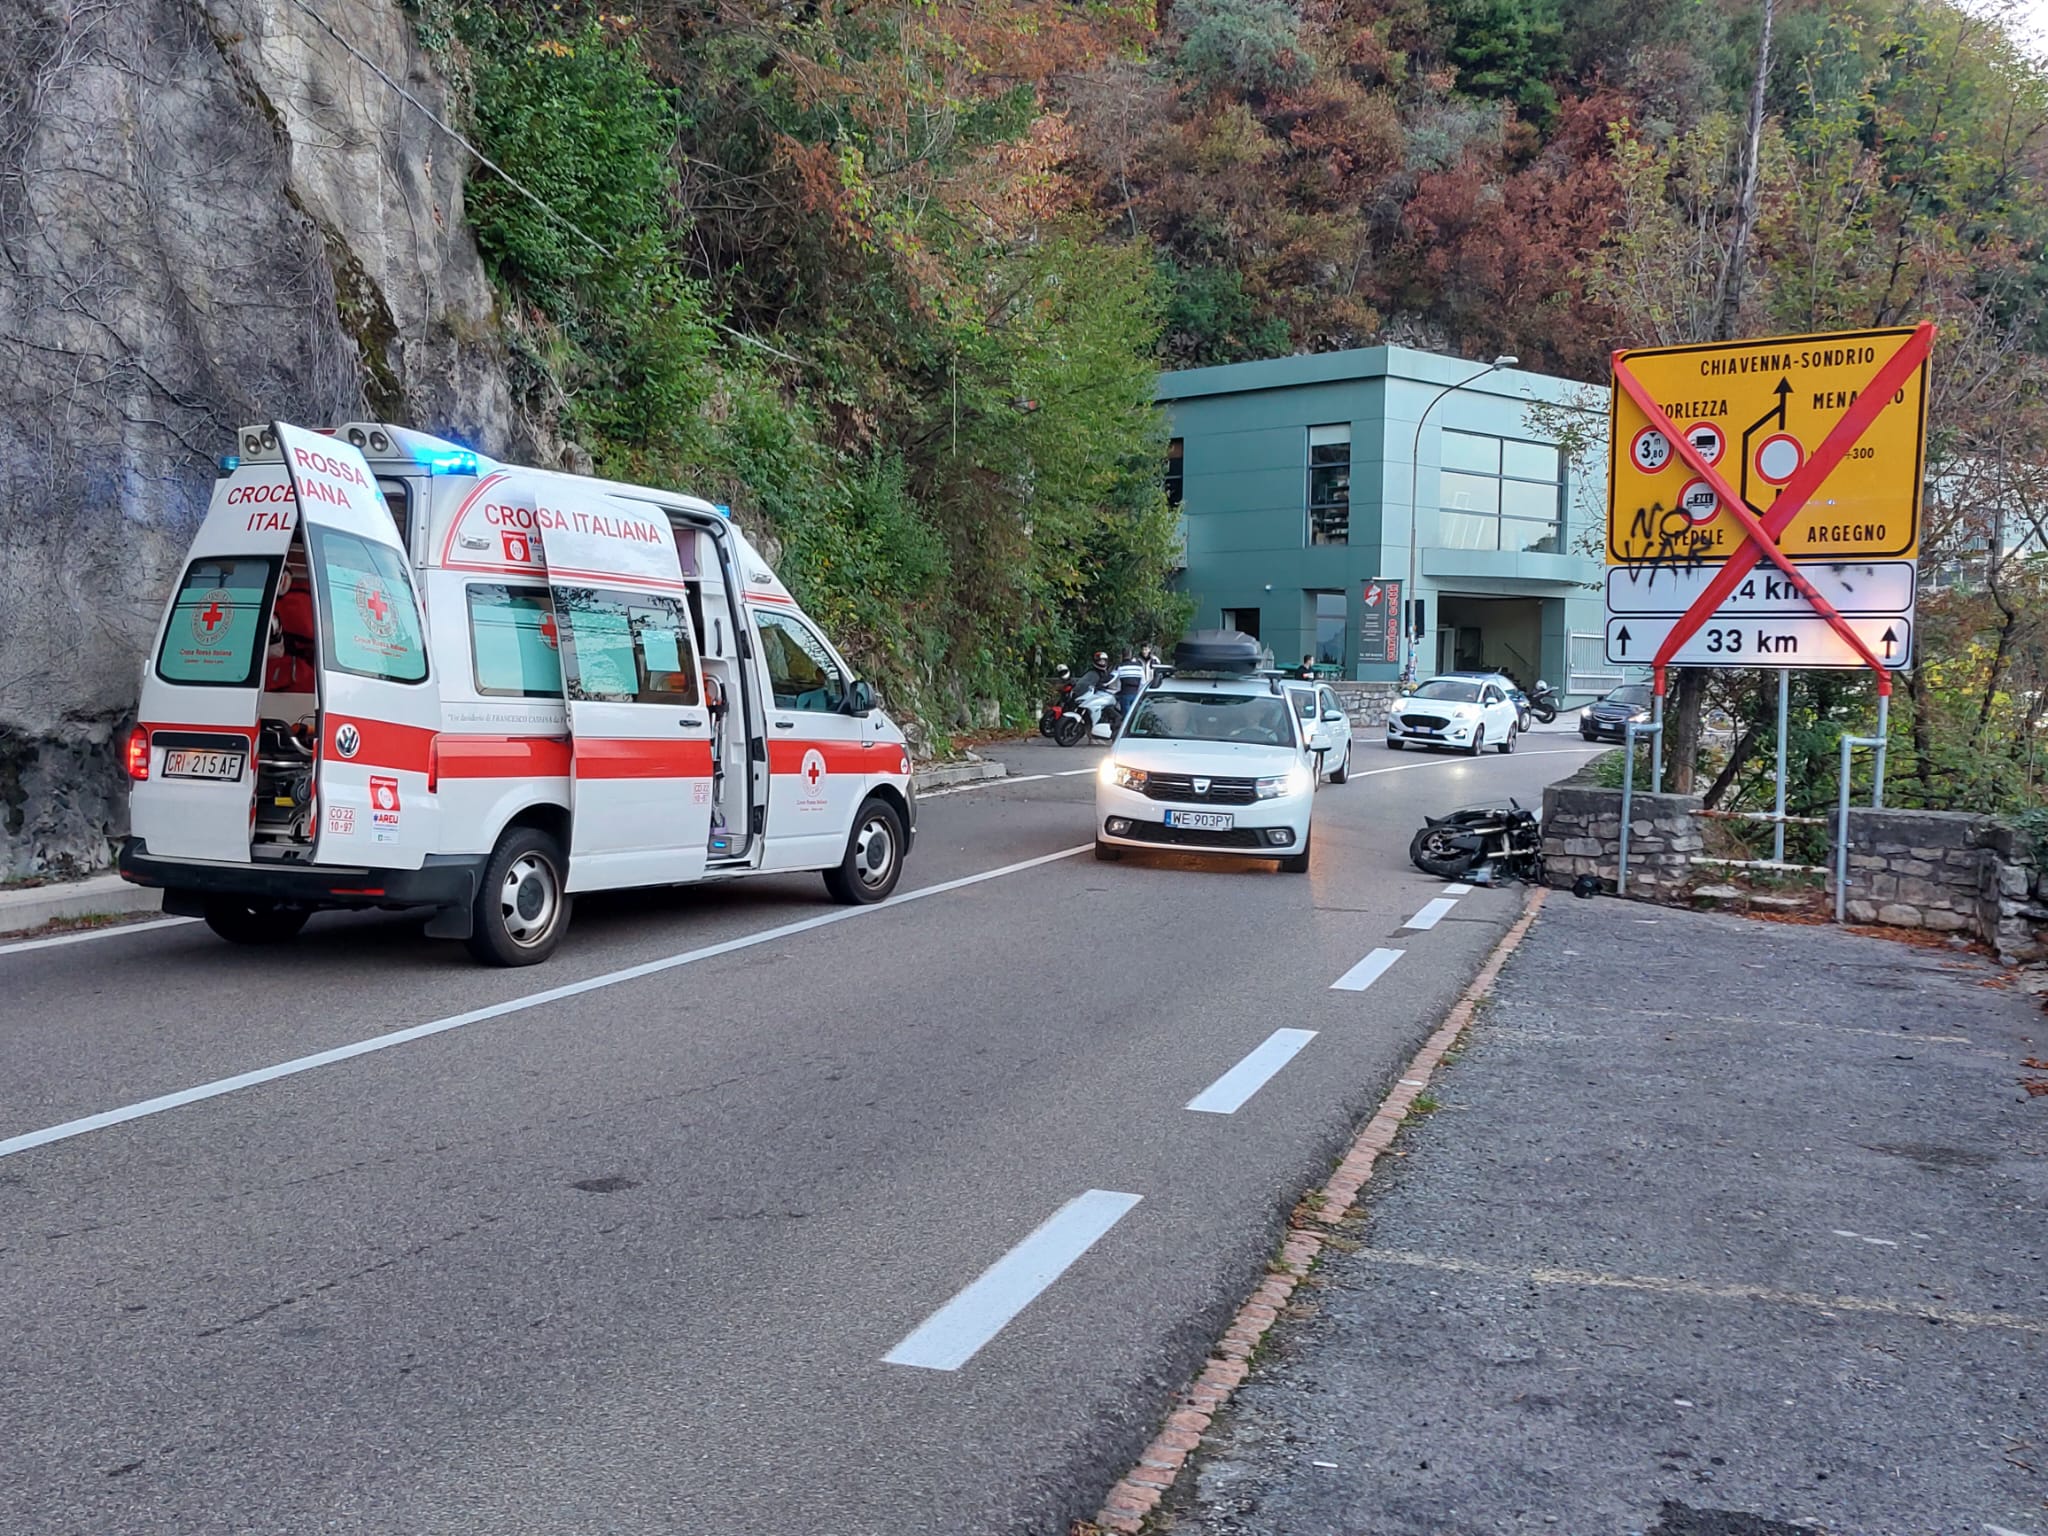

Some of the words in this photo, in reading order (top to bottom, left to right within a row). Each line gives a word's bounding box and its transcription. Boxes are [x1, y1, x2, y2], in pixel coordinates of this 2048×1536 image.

[1700, 346, 1876, 377] CHIAVENNA-SONDRIO
[1812, 388, 1905, 410] MENAO
[295, 447, 370, 488] ROSSA
[247, 512, 292, 532] ITAL
[572, 511, 662, 544] ITALIANA
[1630, 501, 1694, 540] NO
[1807, 523, 1887, 544] ARGEGNO
[1707, 629, 1743, 653] 33
[1757, 630, 1798, 653] km
[167, 752, 186, 773] CRI
[343, 809, 354, 820] 22
[1173, 812, 1192, 825] WE
[1194, 814, 1232, 828] 903PY
